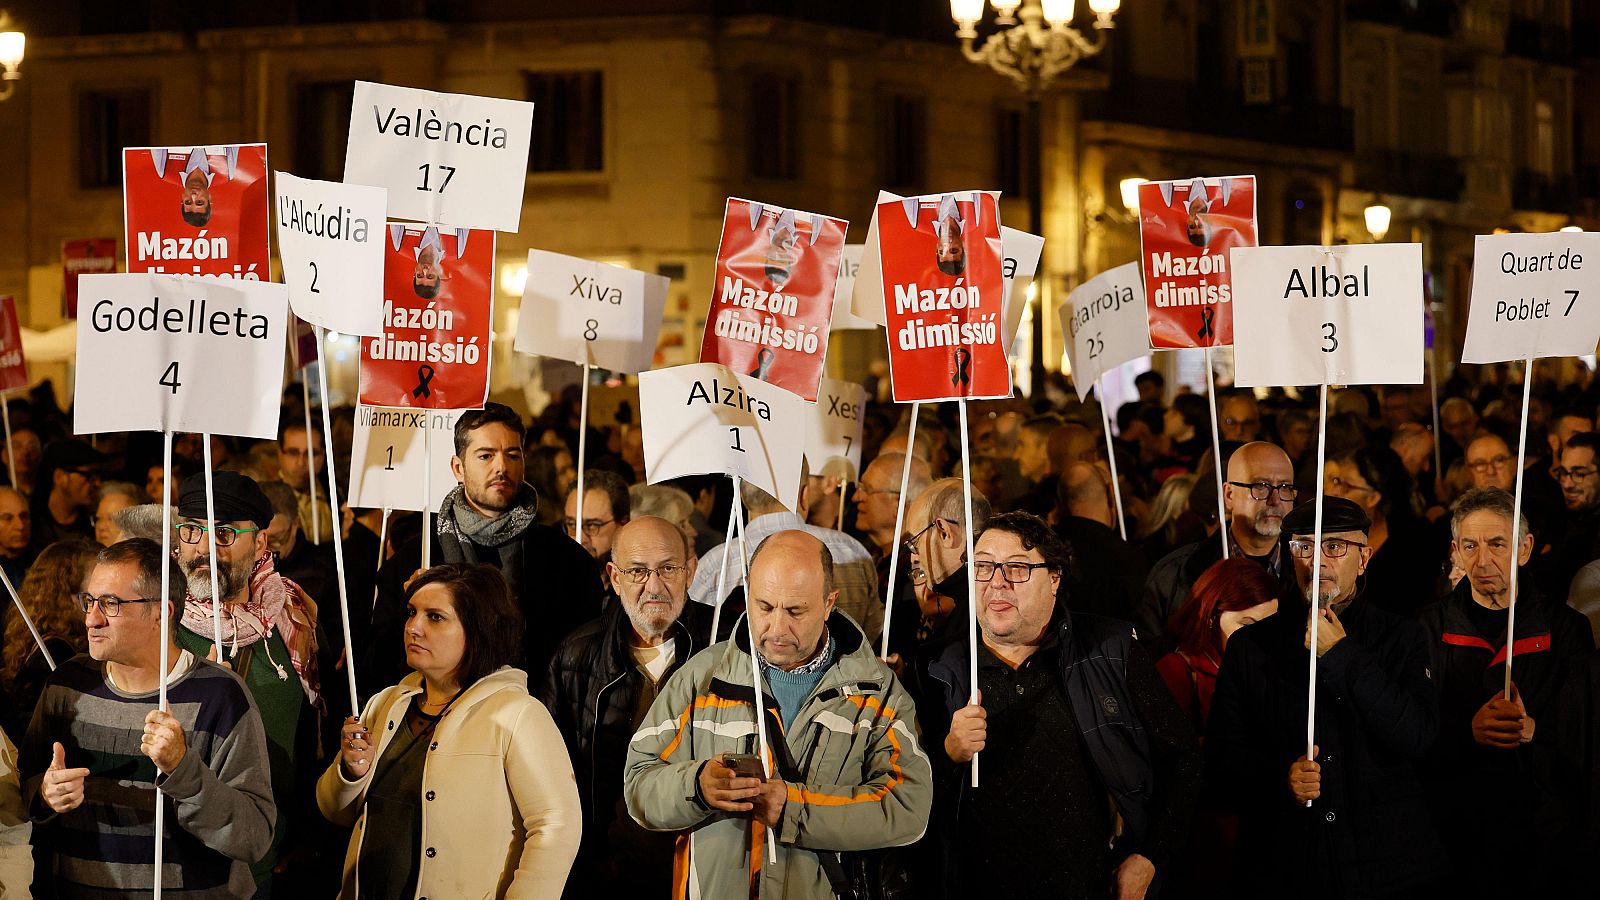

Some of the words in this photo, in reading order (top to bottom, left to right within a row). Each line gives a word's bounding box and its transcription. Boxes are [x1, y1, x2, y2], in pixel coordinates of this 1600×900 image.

[374, 105, 508, 149] València
[416, 163, 456, 194] 17
[279, 195, 369, 243] L'Alcúdia
[137, 229, 228, 261] Mazón
[1501, 251, 1554, 275] Quart
[1558, 247, 1583, 270] de
[309, 261, 320, 293] 2
[1151, 248, 1226, 278] Mazón
[570, 274, 622, 305] Xiva
[721, 275, 798, 317] Mazón
[894, 277, 980, 315] Mazón
[1155, 279, 1231, 308] dimiss
[1283, 264, 1369, 298] Albal
[91, 296, 269, 340] Godelleta
[1495, 297, 1550, 322] Poblet
[1563, 290, 1580, 316] 7
[583, 318, 598, 341] 8
[715, 310, 819, 354] dimissió
[898, 312, 996, 351] dimissió
[1086, 331, 1105, 360] 25
[1321, 322, 1339, 353] 3
[370, 333, 480, 365] dimissió
[158, 361, 182, 394] 4
[687, 378, 771, 422] Alzira
[828, 394, 862, 421] Xes
[360, 407, 454, 430] Vilamarxant
[729, 426, 746, 453] 1
[842, 435, 853, 457] 7
[384, 445, 395, 471] 1
